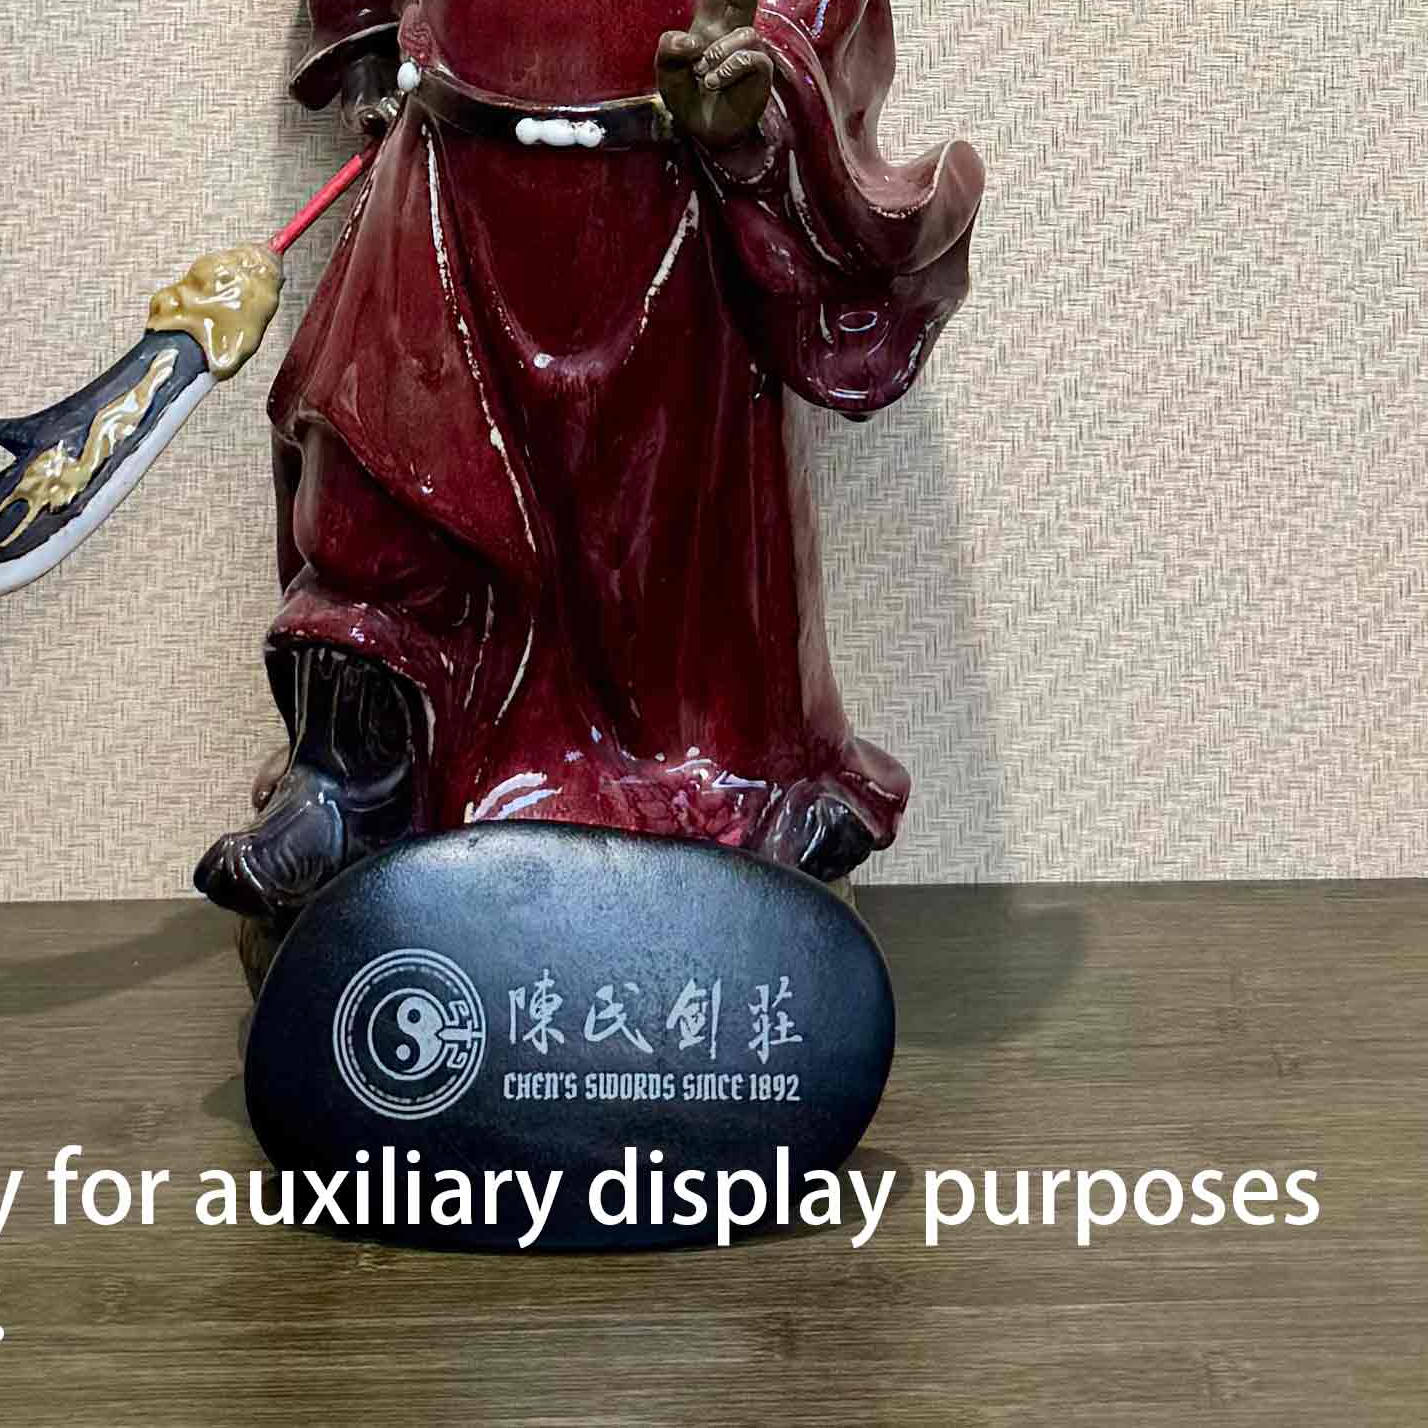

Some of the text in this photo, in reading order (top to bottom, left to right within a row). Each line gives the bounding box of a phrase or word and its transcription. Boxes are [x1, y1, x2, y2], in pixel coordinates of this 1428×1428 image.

[504, 1072, 801, 1101] CHEN'S SWORDS SINCE 1892
